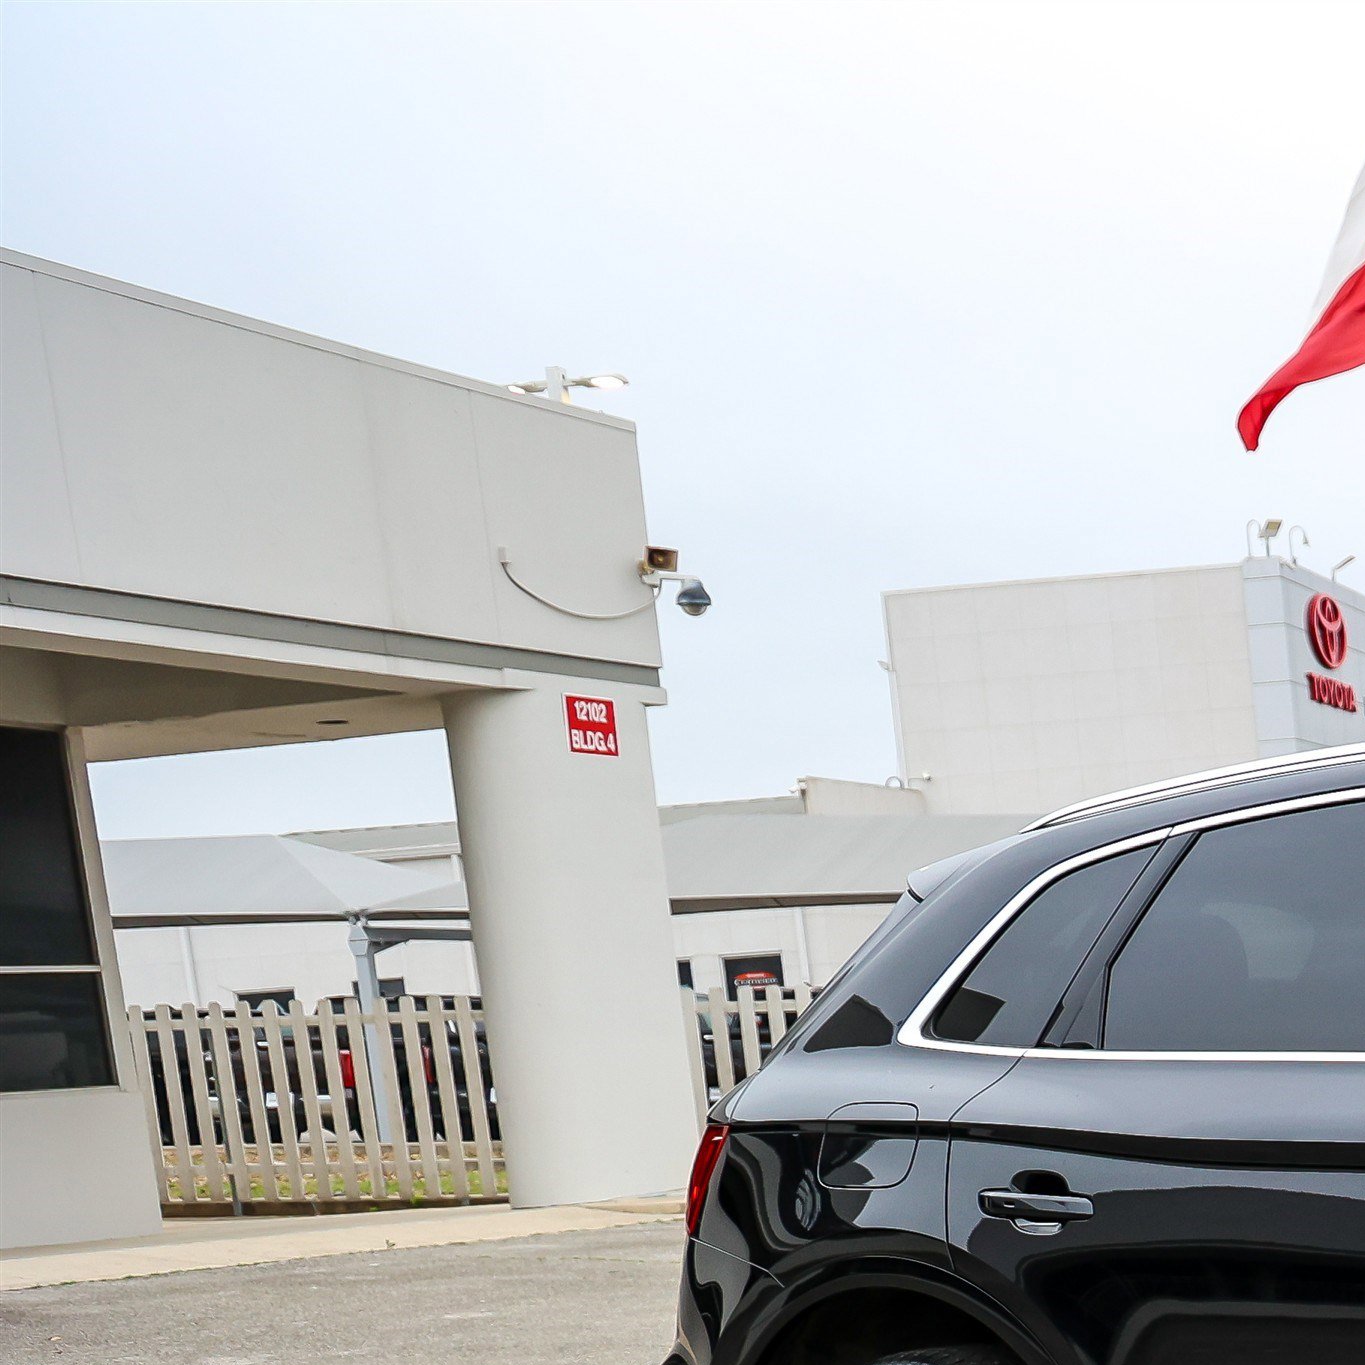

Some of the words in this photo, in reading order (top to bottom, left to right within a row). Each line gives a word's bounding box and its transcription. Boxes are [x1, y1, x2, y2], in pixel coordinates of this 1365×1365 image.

[1306, 672, 1357, 713] TOYOTA
[573, 700, 608, 723] 12102
[571, 729, 607, 752] BLDG
[607, 733, 616, 752] 4
